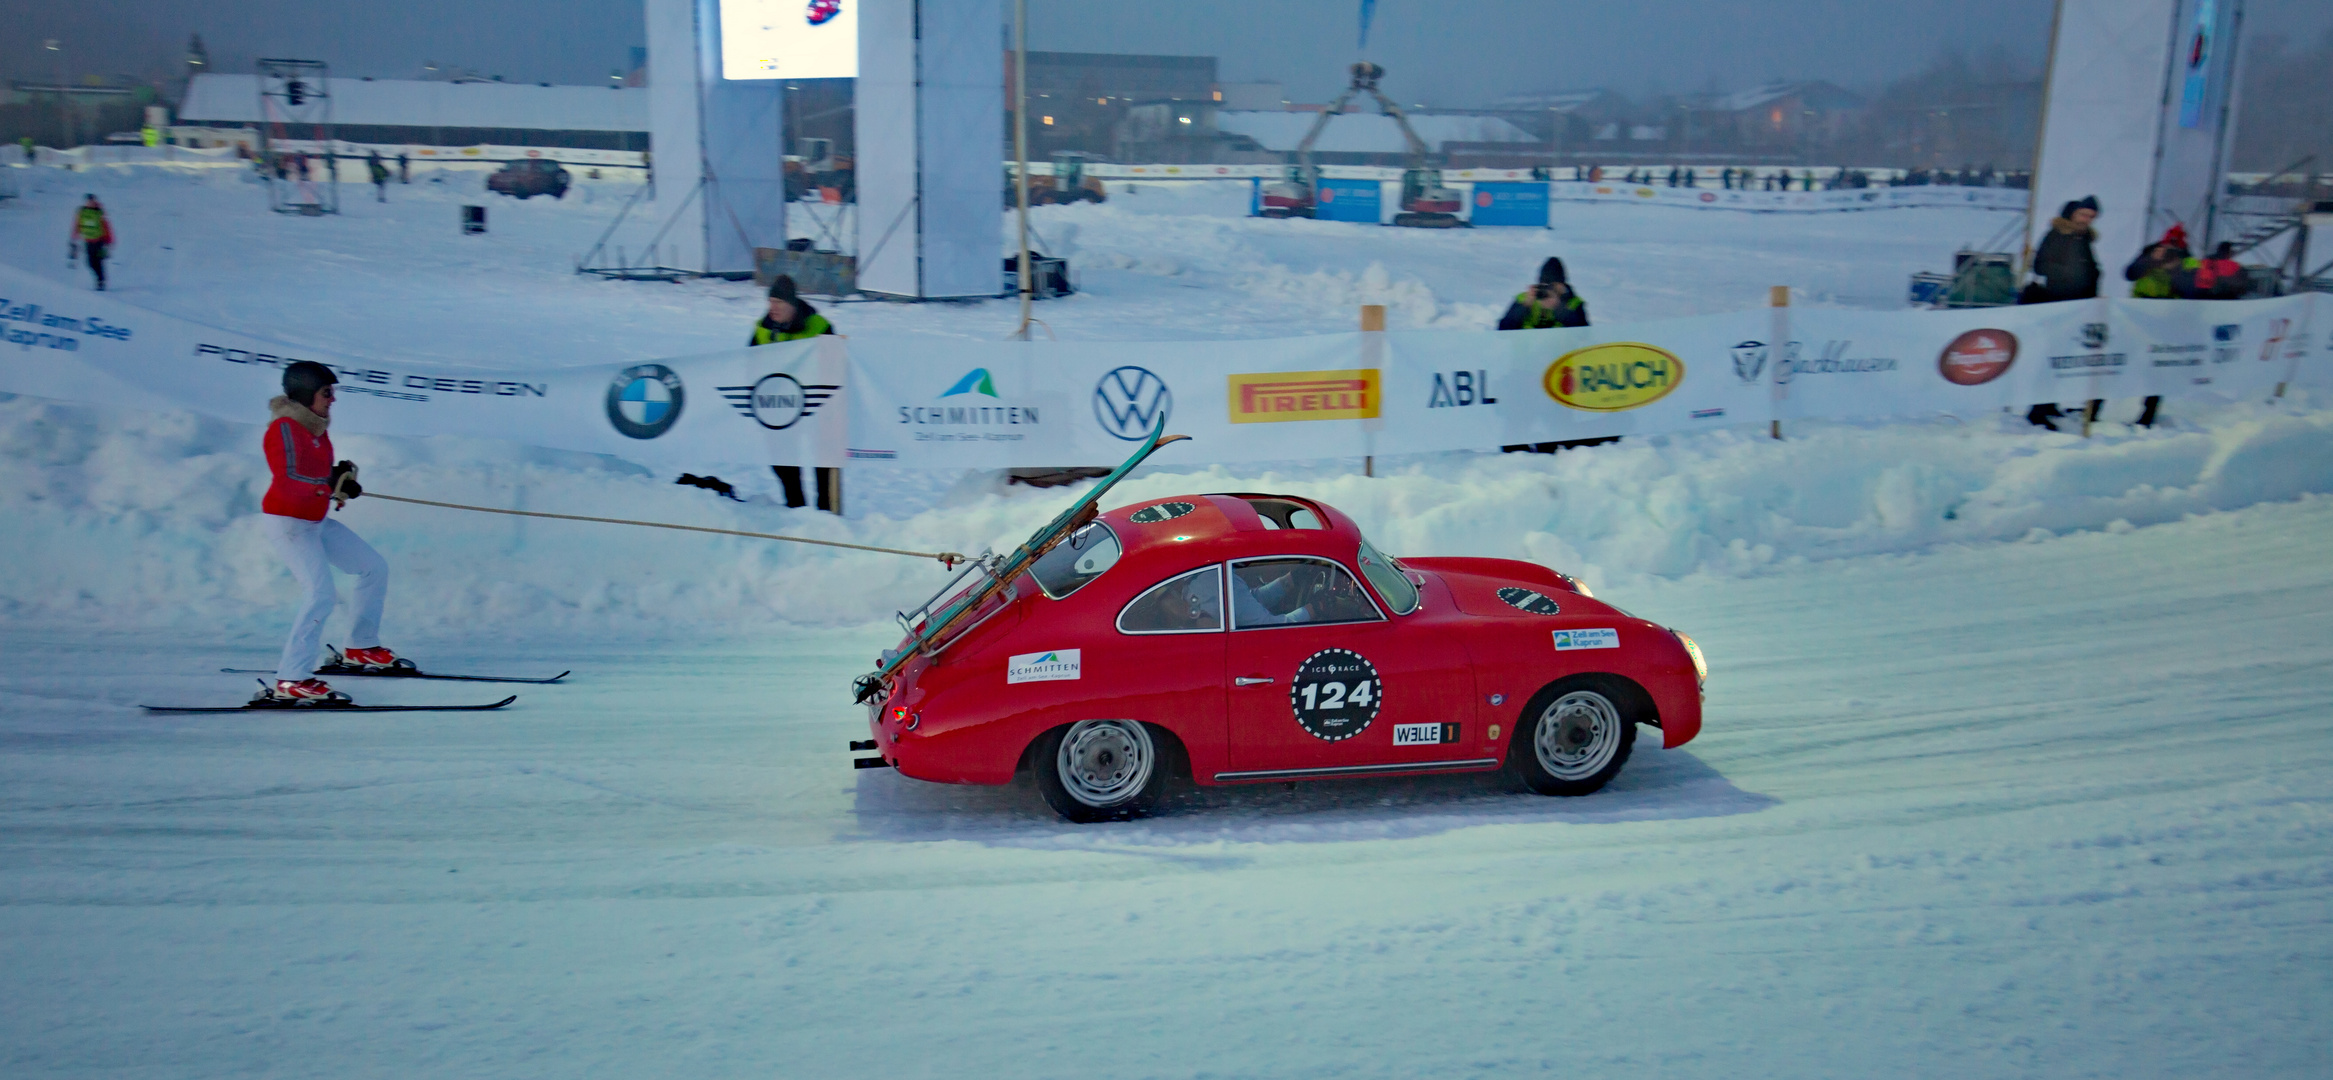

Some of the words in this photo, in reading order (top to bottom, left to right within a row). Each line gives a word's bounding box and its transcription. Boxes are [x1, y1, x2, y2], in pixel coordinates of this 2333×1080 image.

[83, 317, 132, 341] See
[402, 375, 548, 398] DESIGN
[1579, 359, 1668, 393] RAUCH
[1240, 379, 1368, 413] PIRELLI
[1427, 370, 1497, 408] ABL
[898, 406, 1040, 424] SCHMITTEN
[1573, 639, 1602, 648] Kaprun
[1010, 663, 1079, 676] SCHMITTEN
[1301, 680, 1373, 710] 124
[1447, 725, 1454, 740] 1
